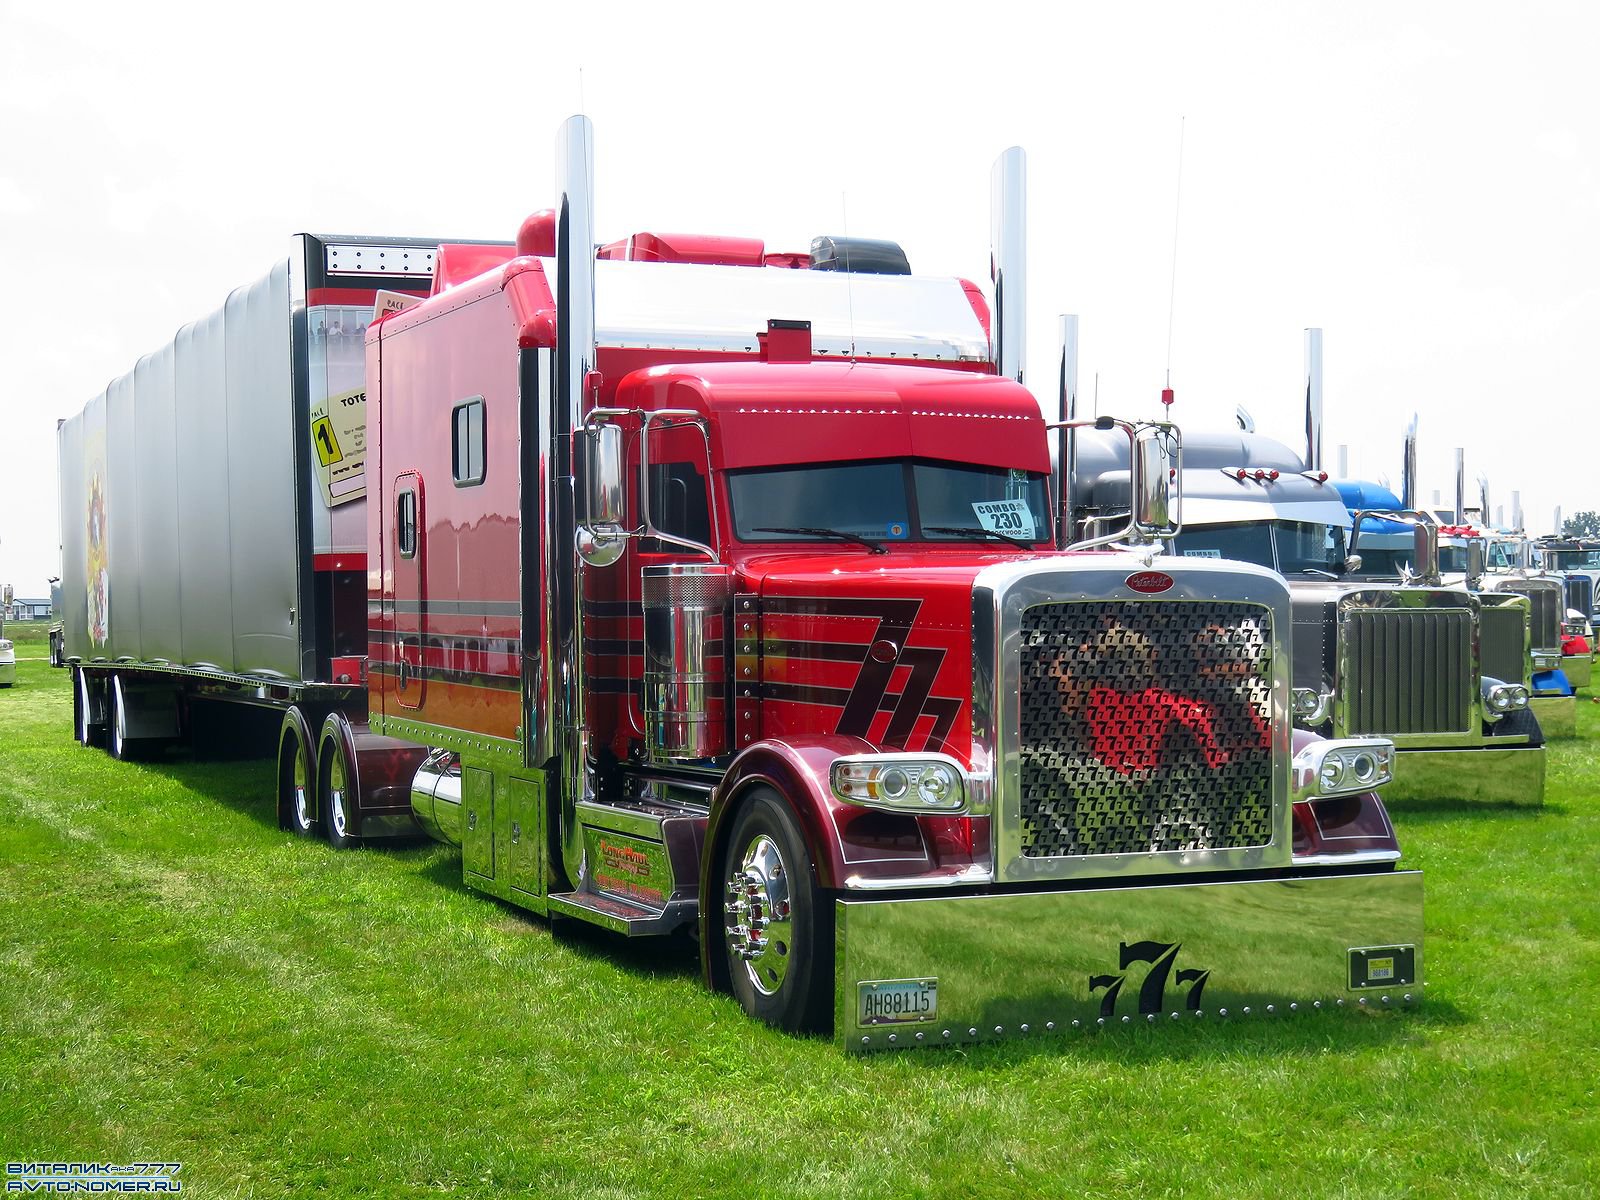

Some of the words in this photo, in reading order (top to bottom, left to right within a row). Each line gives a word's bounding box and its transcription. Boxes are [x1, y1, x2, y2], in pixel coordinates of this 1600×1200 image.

[317, 423, 334, 455] 1
[977, 503, 1016, 514] COMBO
[990, 512, 1023, 530] 230
[864, 990, 930, 1016] AH88115
